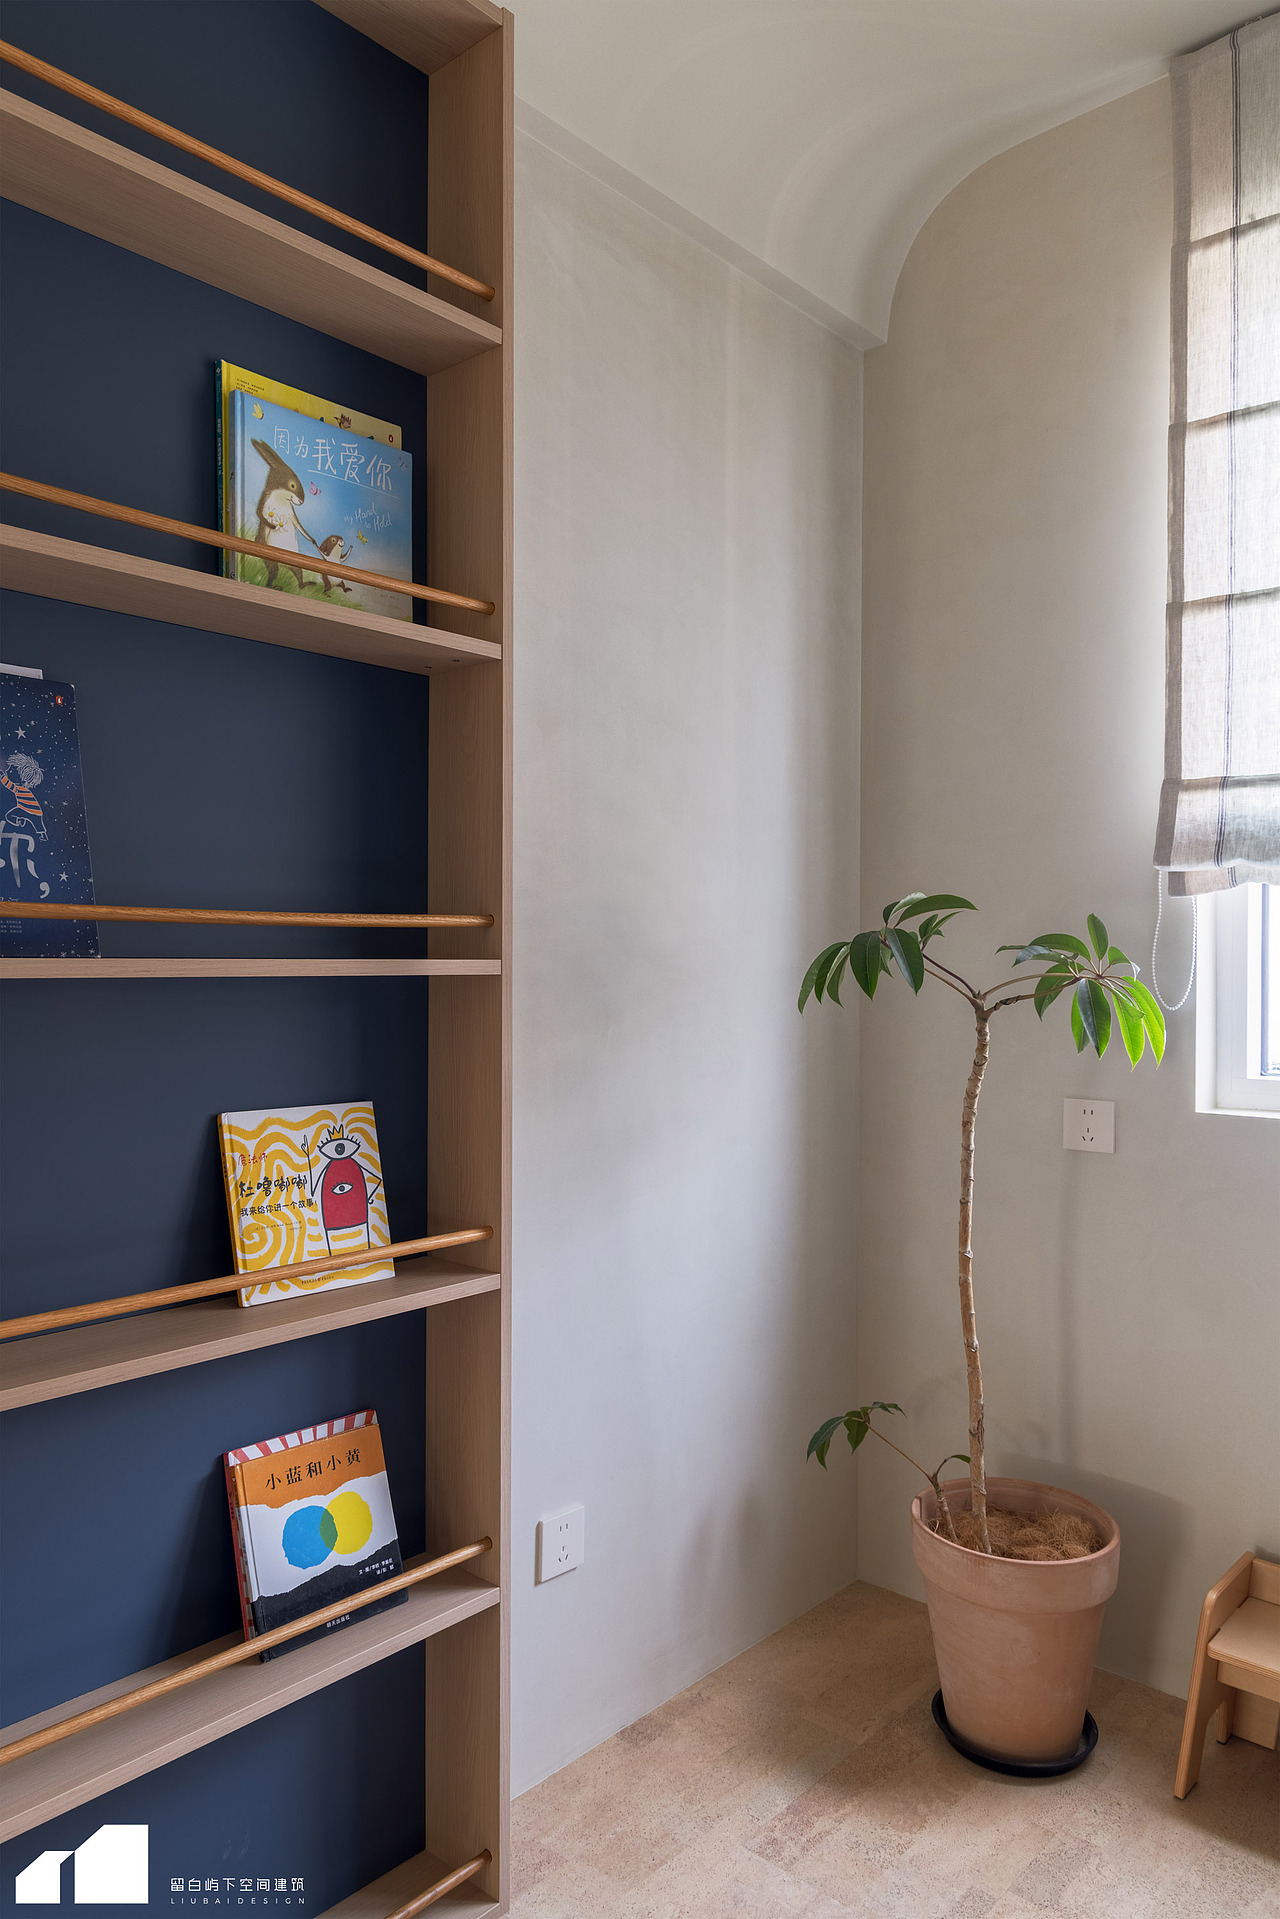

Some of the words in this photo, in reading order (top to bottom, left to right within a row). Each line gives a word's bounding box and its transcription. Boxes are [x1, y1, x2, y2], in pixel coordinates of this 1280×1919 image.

[273, 425, 393, 491] 因为我爱你
[354, 501, 377, 523] Hand
[373, 512, 392, 532] Hold
[264, 1447, 362, 1491] 小蓝和小黄
